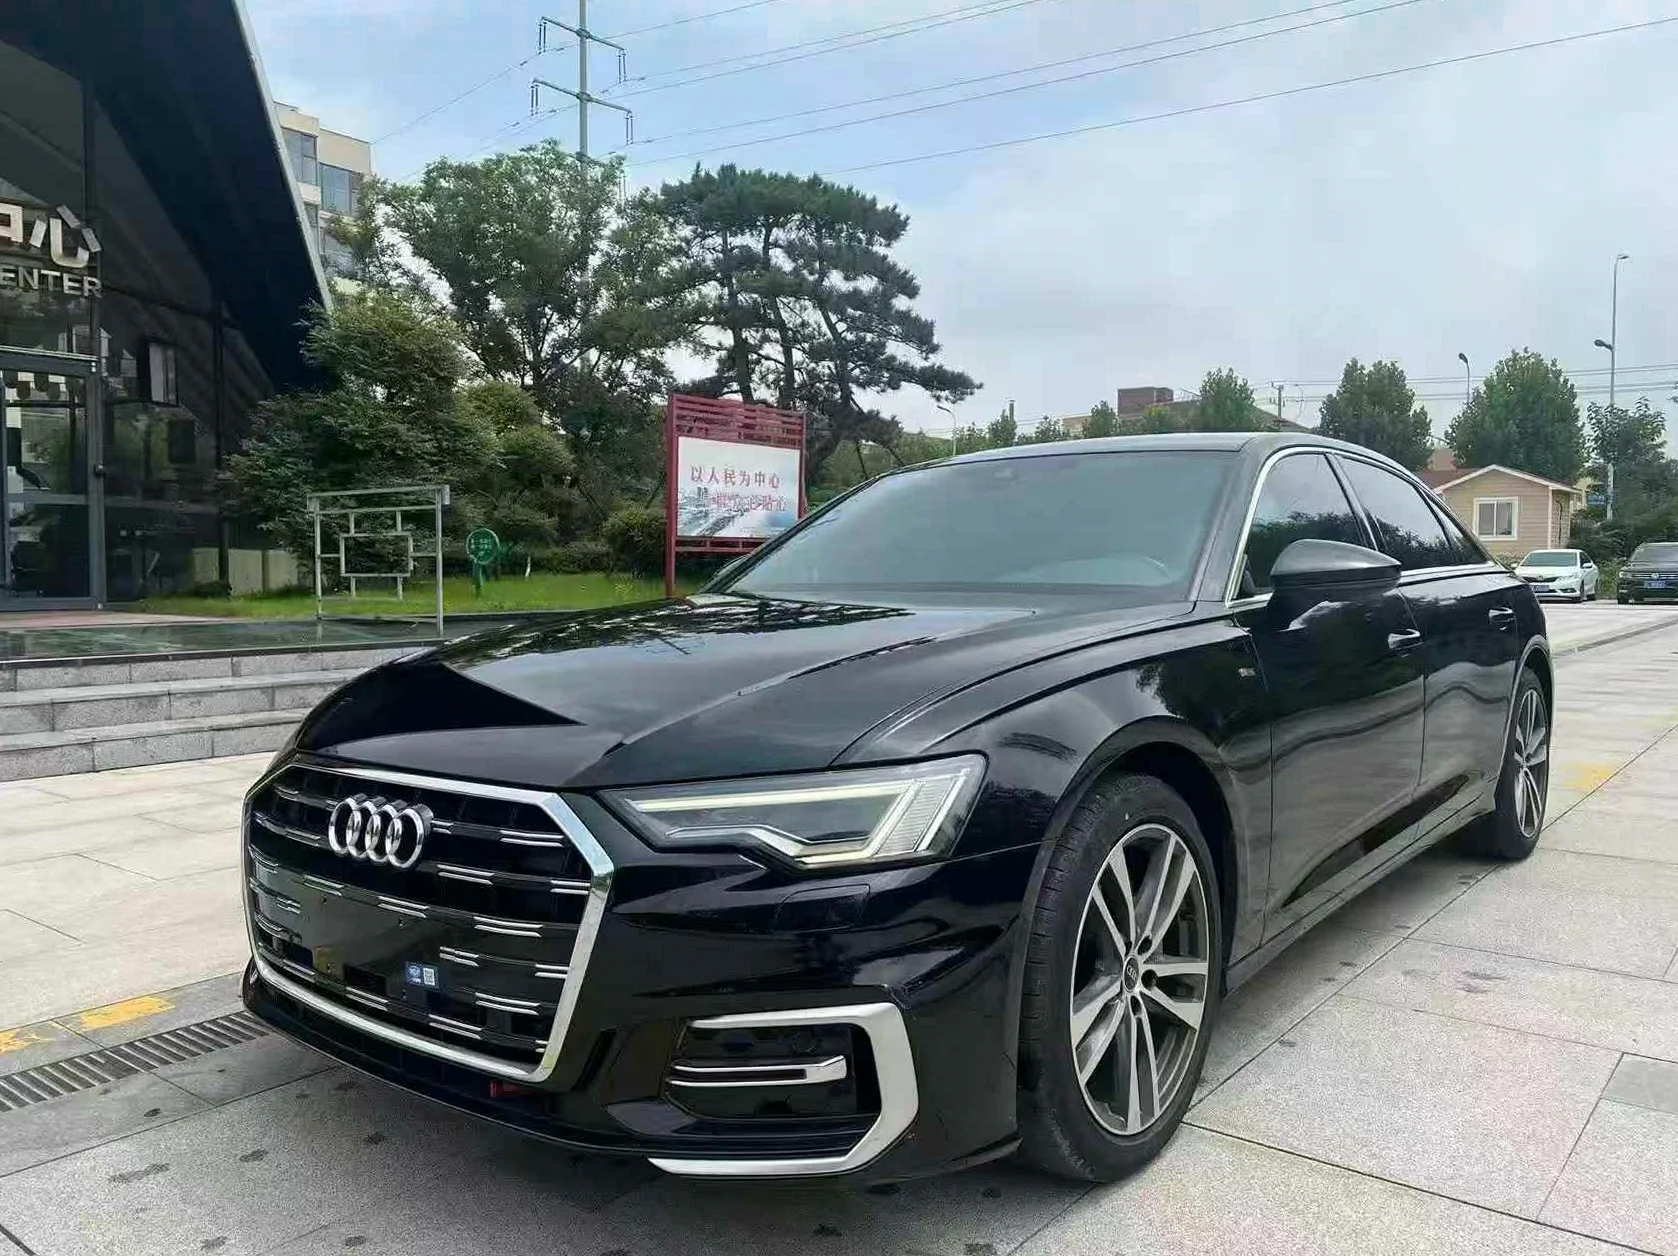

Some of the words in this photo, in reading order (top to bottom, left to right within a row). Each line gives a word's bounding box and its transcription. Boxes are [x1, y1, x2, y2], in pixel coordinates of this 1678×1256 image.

[690, 464, 780, 488] 以人民为中心
